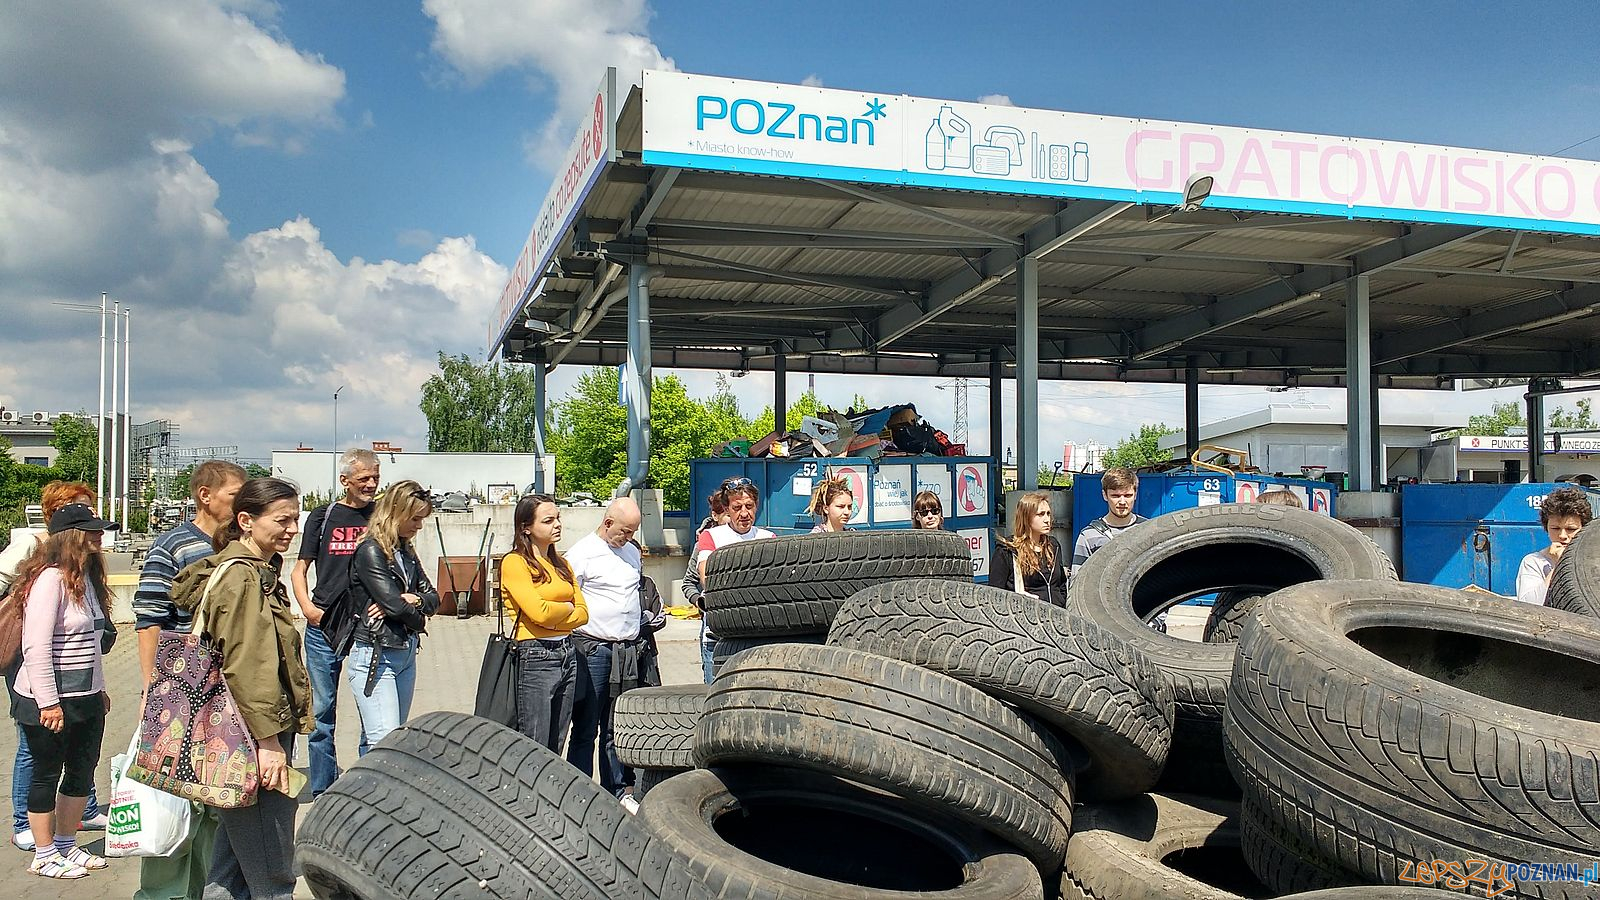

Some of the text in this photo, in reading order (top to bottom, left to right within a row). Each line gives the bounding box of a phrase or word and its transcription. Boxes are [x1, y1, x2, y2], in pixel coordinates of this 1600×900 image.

[696, 140, 794, 159] Miasto know-how
[1124, 129, 1576, 219] GRATOWISKO
[1491, 440, 1521, 449] PUNKT
[803, 463, 818, 477] 52
[1203, 478, 1220, 491] 63
